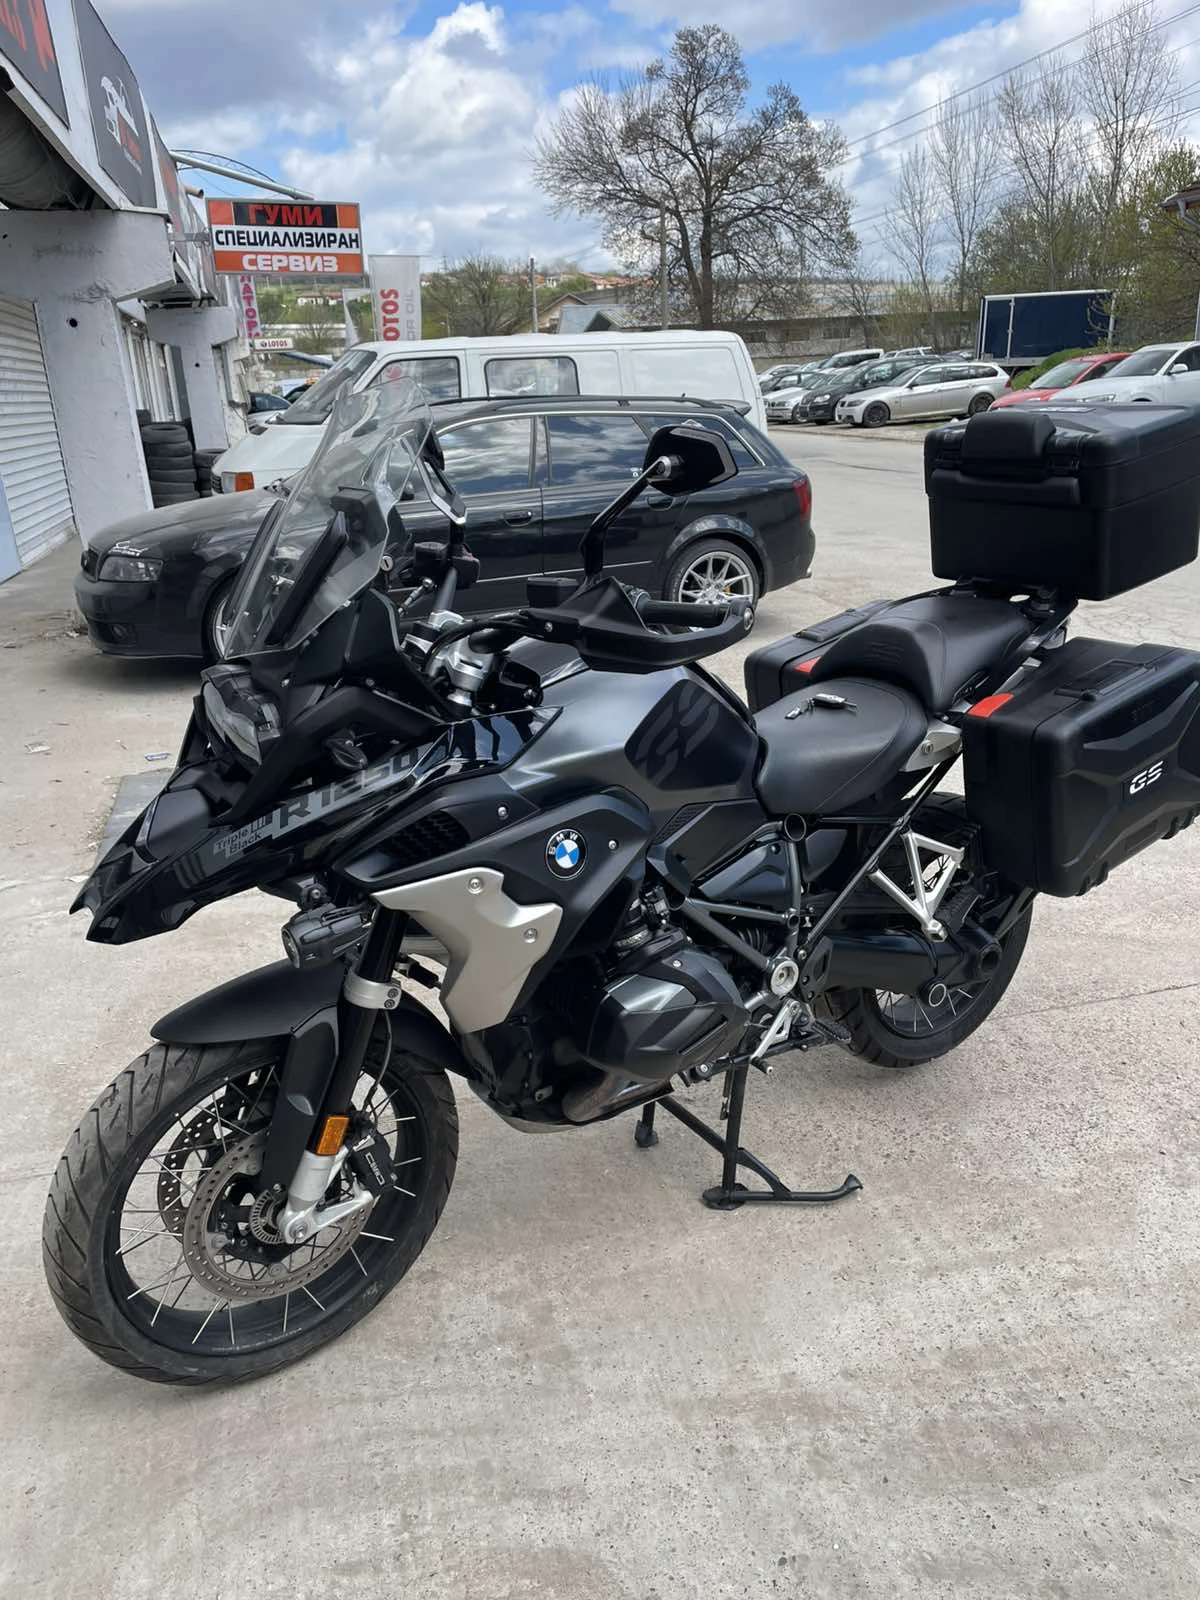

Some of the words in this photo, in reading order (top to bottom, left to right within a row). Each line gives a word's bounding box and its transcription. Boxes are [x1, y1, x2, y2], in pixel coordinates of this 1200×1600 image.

[248, 205, 323, 226] ГУМИ
[215, 229, 360, 249] СПЕЦИАЛИЗИРАН
[241, 254, 338, 272] СЕРВИЗ
[1129, 760, 1164, 794] GS
[216, 829, 250, 849] Triple
[230, 831, 262, 854] Black
[548, 832, 579, 855] BMW
